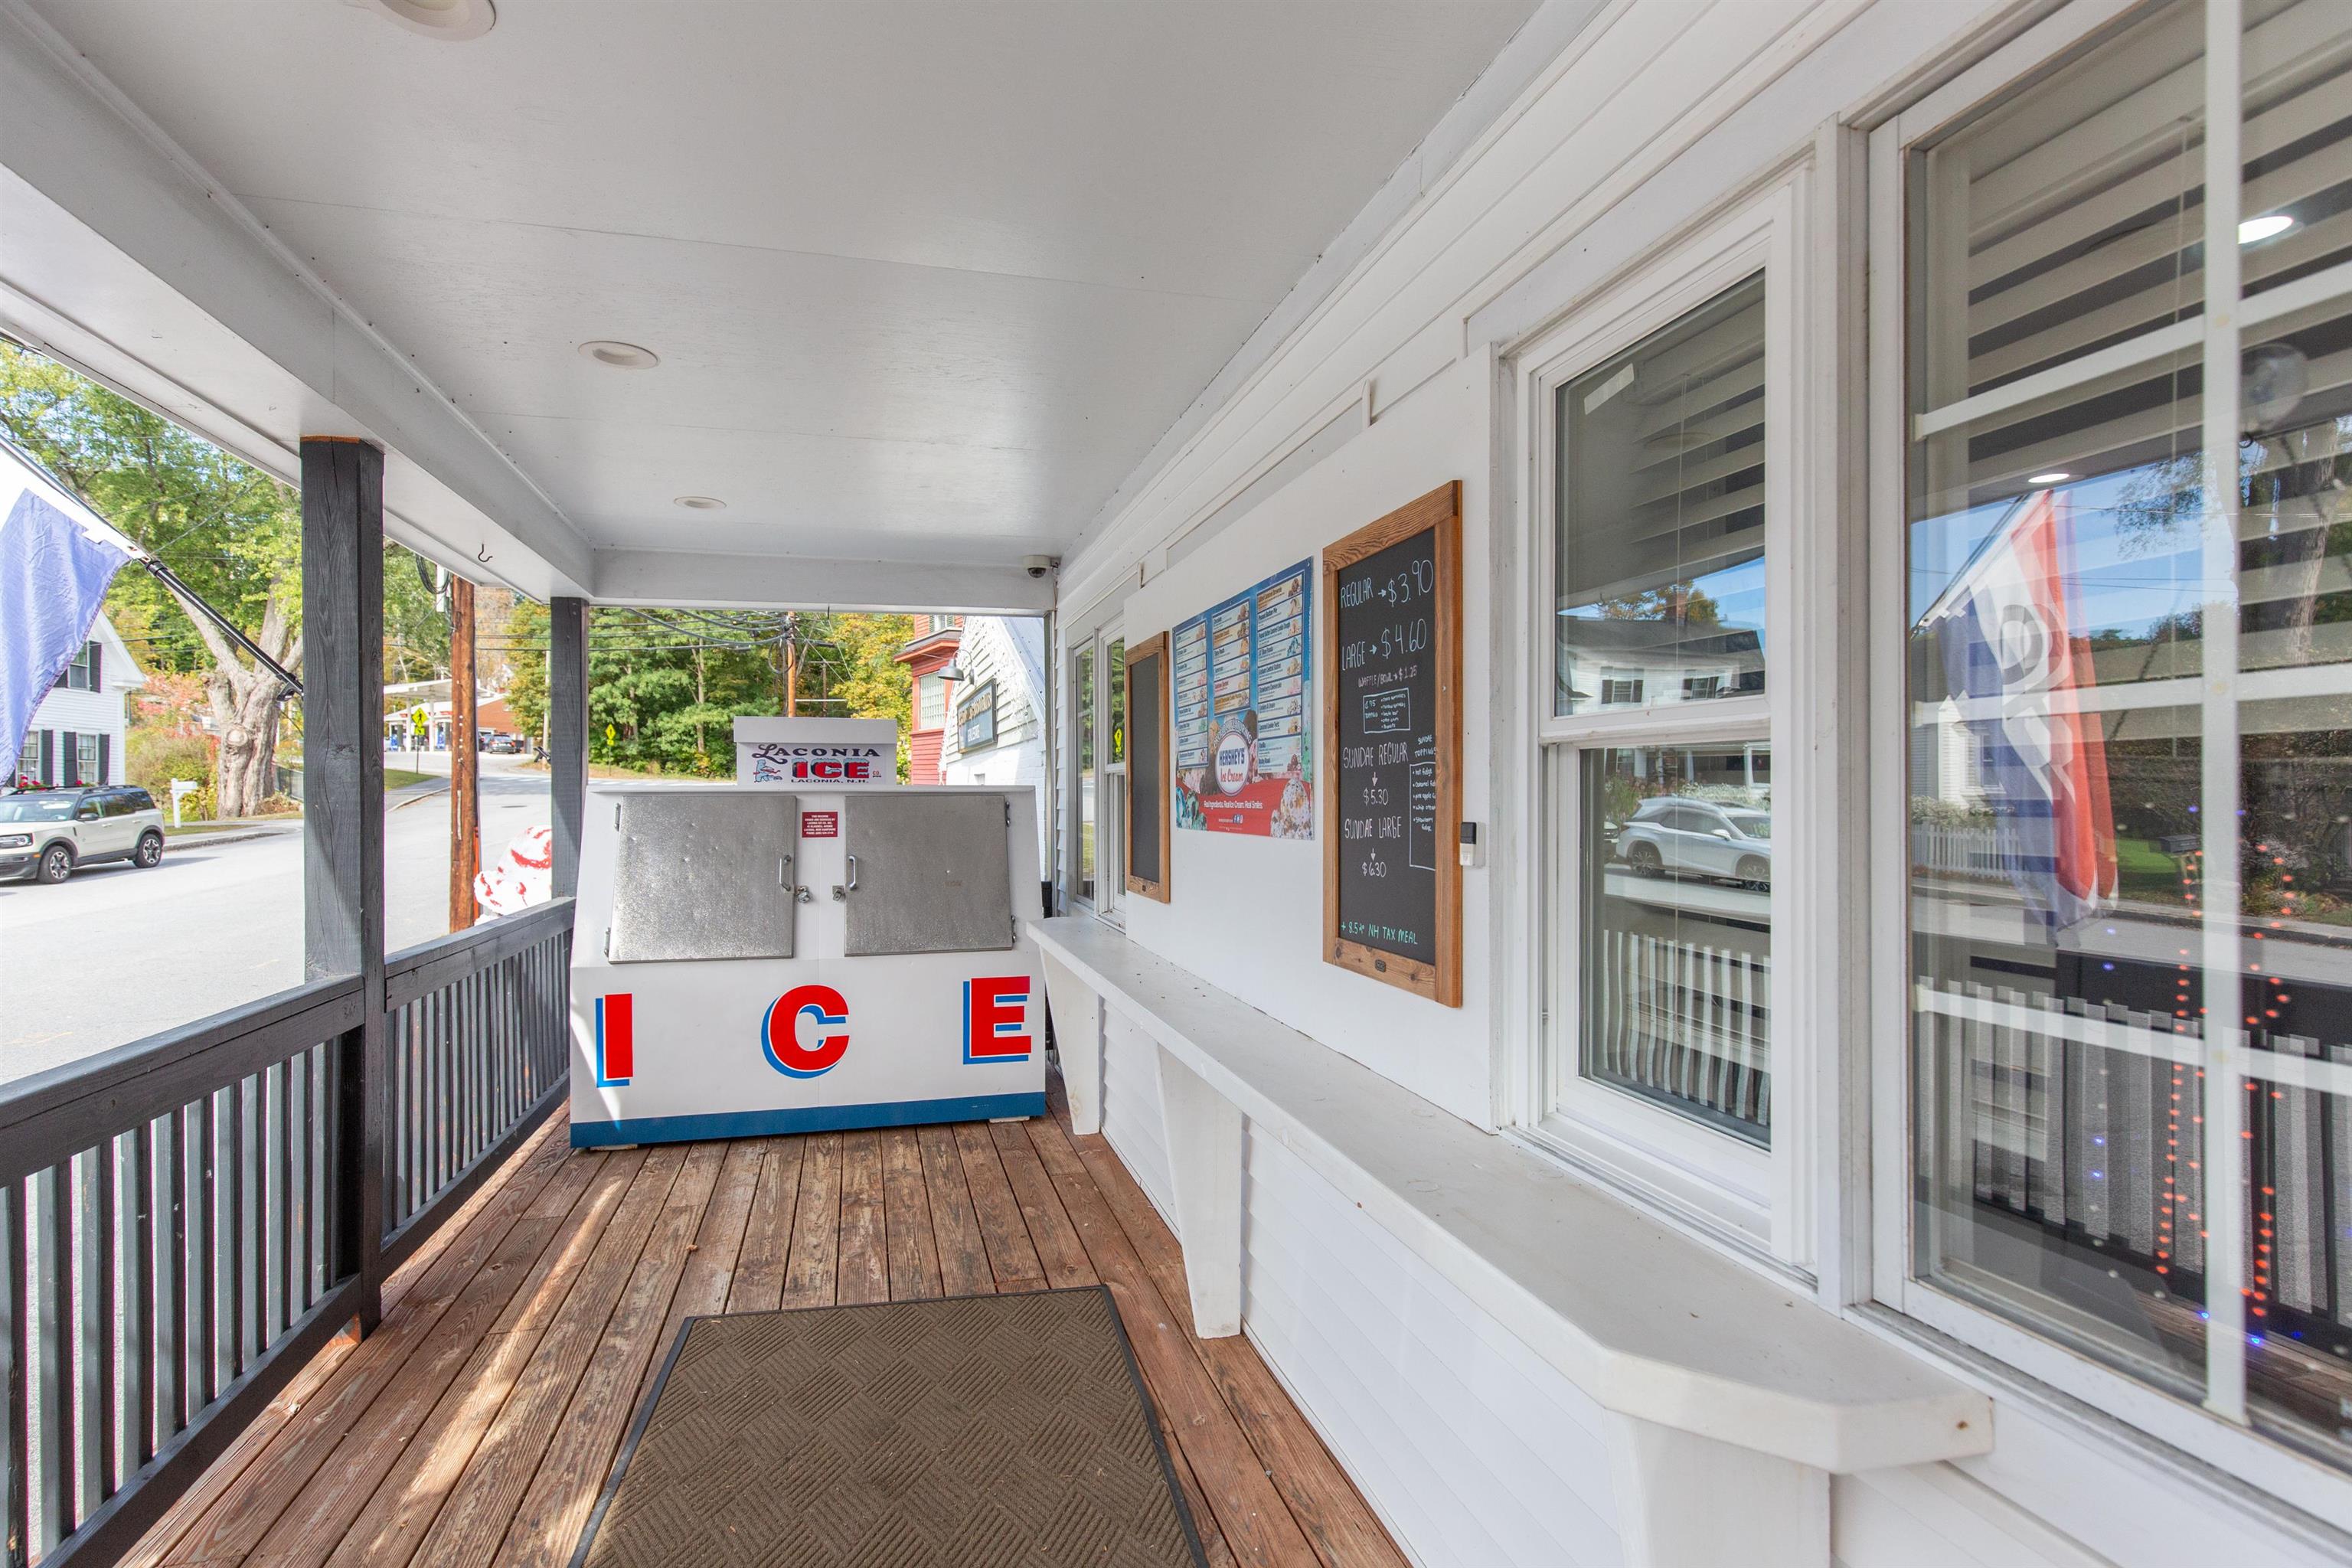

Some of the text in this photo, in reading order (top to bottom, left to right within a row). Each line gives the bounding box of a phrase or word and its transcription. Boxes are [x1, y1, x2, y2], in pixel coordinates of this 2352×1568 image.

[1341, 560, 1433, 609] REGULAR $3.90
[1341, 619, 1427, 671] LARGE $4.60
[751, 743, 880, 764] LACONIA
[1219, 747, 1245, 766] HERSHEY'S
[1343, 741, 1409, 769] SUNDAE REGULAR
[791, 757, 870, 778] ICE
[1363, 787, 1389, 807] $5.30
[1344, 815, 1402, 840] SUNDAE LARGE
[1368, 923, 1380, 939] NH
[1383, 926, 1396, 941] TAX
[1397, 929, 1418, 945] MEAL
